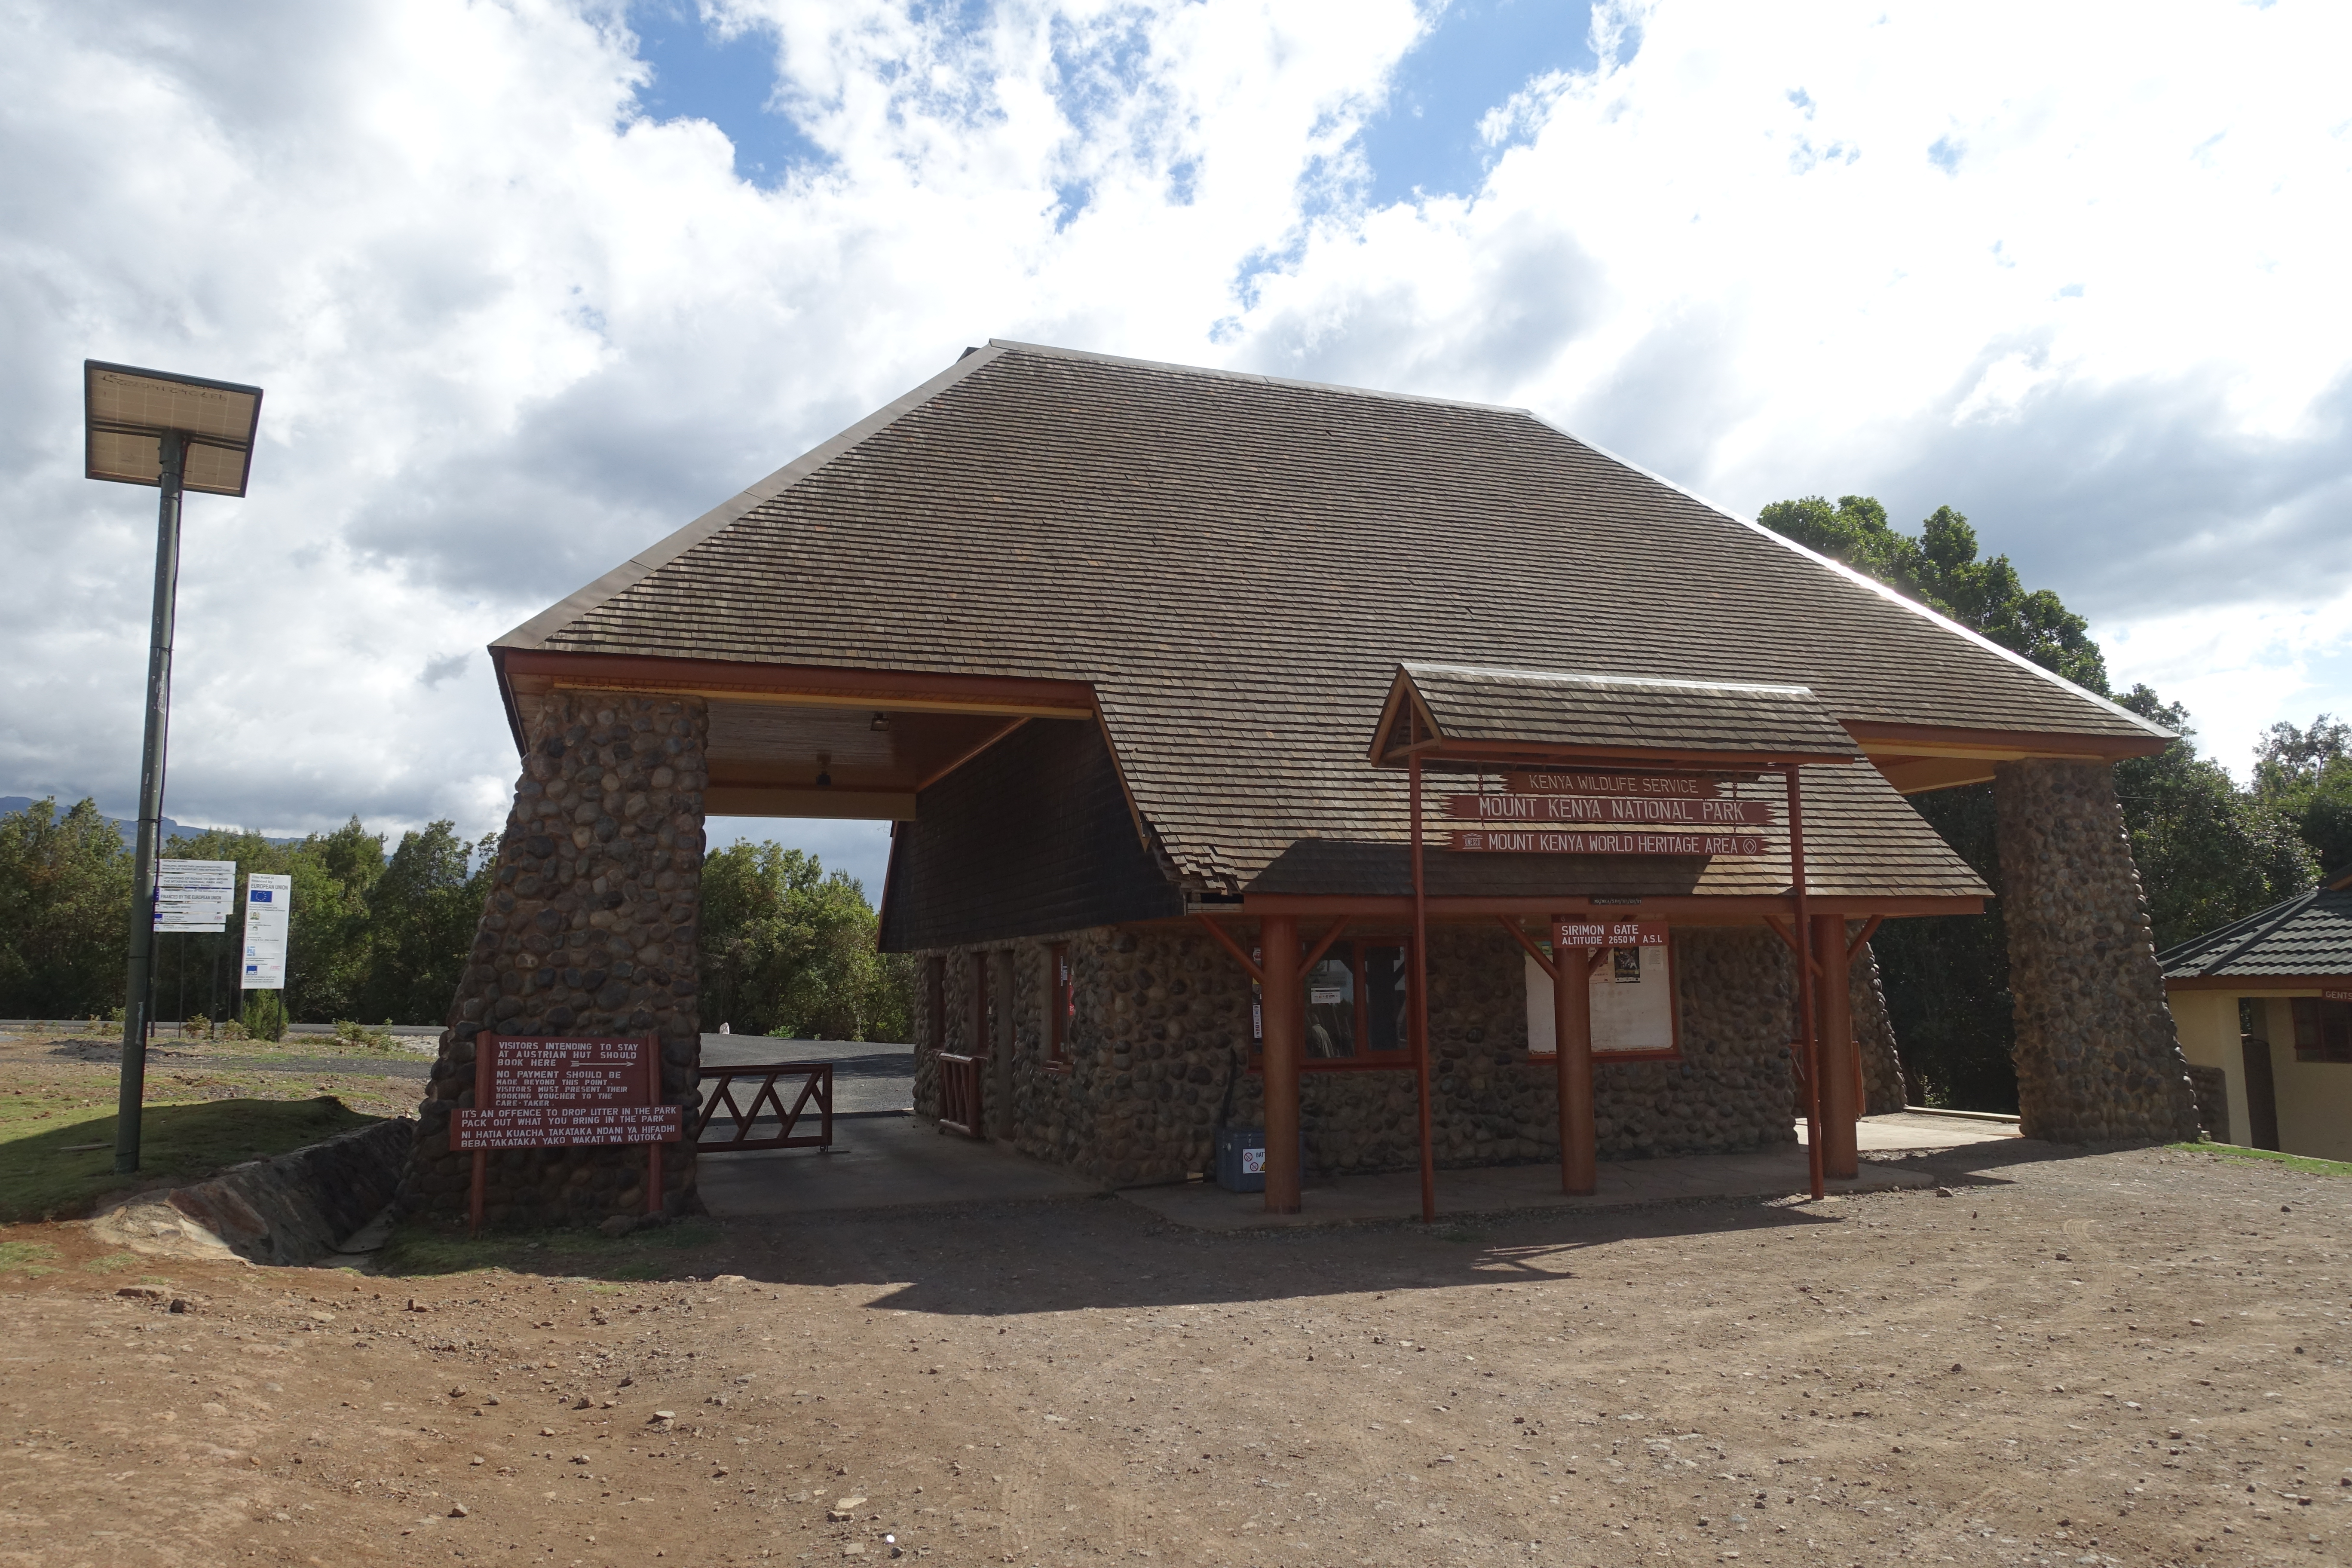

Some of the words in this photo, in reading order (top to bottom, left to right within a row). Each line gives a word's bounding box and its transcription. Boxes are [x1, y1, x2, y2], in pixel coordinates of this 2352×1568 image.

[1529, 775, 1574, 789] KENYA
[1577, 776, 1638, 792] WILDLIFE
[1643, 778, 1699, 794] SERVICE
[1479, 797, 1537, 817] MOUNT
[1548, 799, 1602, 818] KENYA
[1612, 800, 1693, 820] NATIONAL
[1703, 802, 1744, 821] PARK
[1489, 833, 1534, 851] MOUNT
[1540, 834, 1584, 851] KENYA
[1589, 835, 1632, 852] WORLD
[1638, 836, 1700, 853] HERITAGE
[1705, 837, 1738, 854] AREA
[1562, 925, 1604, 935] SIRIMON
[1614, 925, 1639, 934] GATE
[1562, 936, 1602, 945] ALTITUDE
[2326, 991, 2352, 1000] GENTS
[516, 1050, 566, 1059] AUSTRIAN
[600, 1051, 637, 1060] SHOULD
[517, 1070, 559, 1078] PAYMENT
[566, 1071, 602, 1079] SHOULD
[462, 1110, 477, 1118] IT'S
[499, 1109, 542, 1117] OFFENCE
[591, 1108, 618, 1116] LITTER
[654, 1106, 677, 1115] PARK
[461, 1119, 487, 1127] PACK
[518, 1118, 542, 1126] WHAT
[548, 1117, 567, 1125] YOU
[573, 1116, 600, 1124] BRING
[641, 1115, 664, 1123] PARK
[461, 1131, 471, 1139] NI
[476, 1130, 502, 1138] HATIA
[506, 1129, 544, 1137] KUACHA
[548, 1127, 592, 1136] TAKATAKA
[597, 1126, 623, 1135] NDANI
[627, 1126, 637, 1134] YA
[642, 1125, 675, 1133] HIFADHI
[461, 1139, 487, 1148] BEBA
[490, 1137, 536, 1147] TAKATAKA
[542, 1136, 565, 1145] YAKO
[573, 1135, 604, 1143] WAKATI
[628, 1133, 662, 1142] KUTOKA
